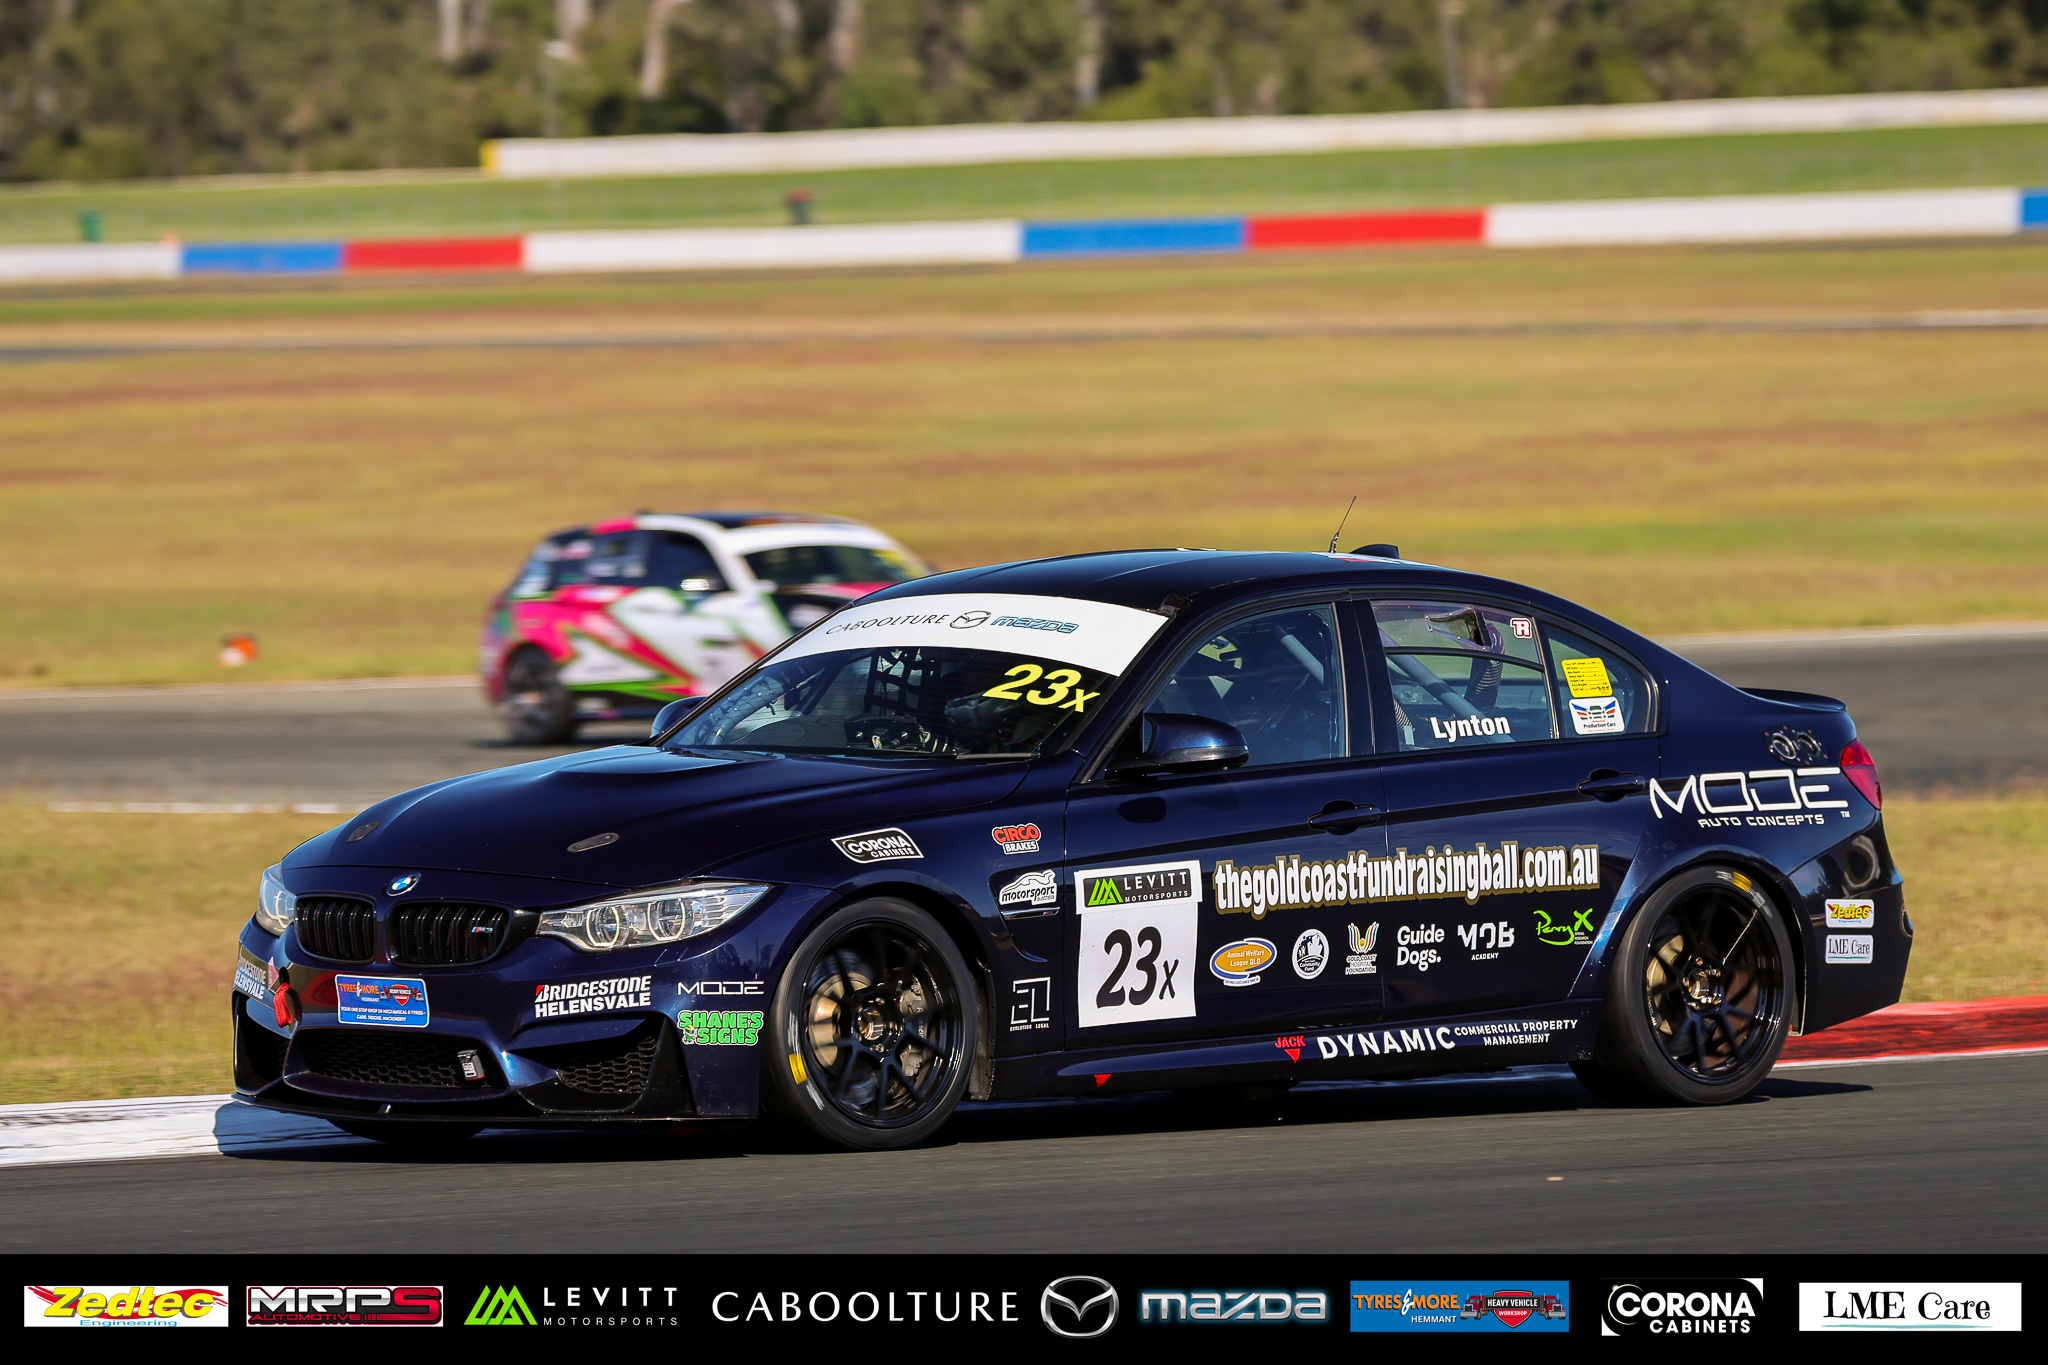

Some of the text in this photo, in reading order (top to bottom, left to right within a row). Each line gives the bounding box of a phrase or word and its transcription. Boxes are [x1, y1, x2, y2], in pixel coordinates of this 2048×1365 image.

[825, 614, 950, 635] CABOOLTURE
[1430, 715, 1511, 743] Lynton
[1650, 767, 1848, 819] MODE
[1698, 813, 1825, 829] AUTO CONCEPTS
[994, 825, 1040, 843] CIRCO
[848, 836, 912, 854] CORONA
[871, 848, 915, 858] CABINETS
[1005, 840, 1037, 852] BRAKES
[1123, 871, 1187, 891] LEVITT
[1214, 844, 1599, 916] thegoldcoastfundraisingball.com.au
[1001, 886, 1055, 902] motorsport
[1125, 890, 1189, 903] MOTORSPORTS
[1831, 904, 1870, 919] Zedtec
[1397, 923, 1445, 946] Guide
[1227, 951, 1245, 959] Animal
[1828, 938, 1870, 955] LME Care
[1396, 946, 1442, 972] Dogs.
[1471, 952, 1499, 961] ACADEMY
[1346, 966, 1376, 974] FOUNDATION
[535, 975, 651, 1003] BRIDGESTONE
[678, 981, 764, 996] MODE
[535, 992, 650, 1018] HELENSVALE
[679, 1011, 762, 1029] SHANE'S
[1454, 1019, 1578, 1037] COMMERCIAL PROPERTY
[696, 1027, 757, 1044] SIGNS
[1274, 1035, 1306, 1048] JACK
[1316, 1026, 1456, 1060] DYNAMIC
[1483, 1033, 1550, 1047] MANAGEMENT
